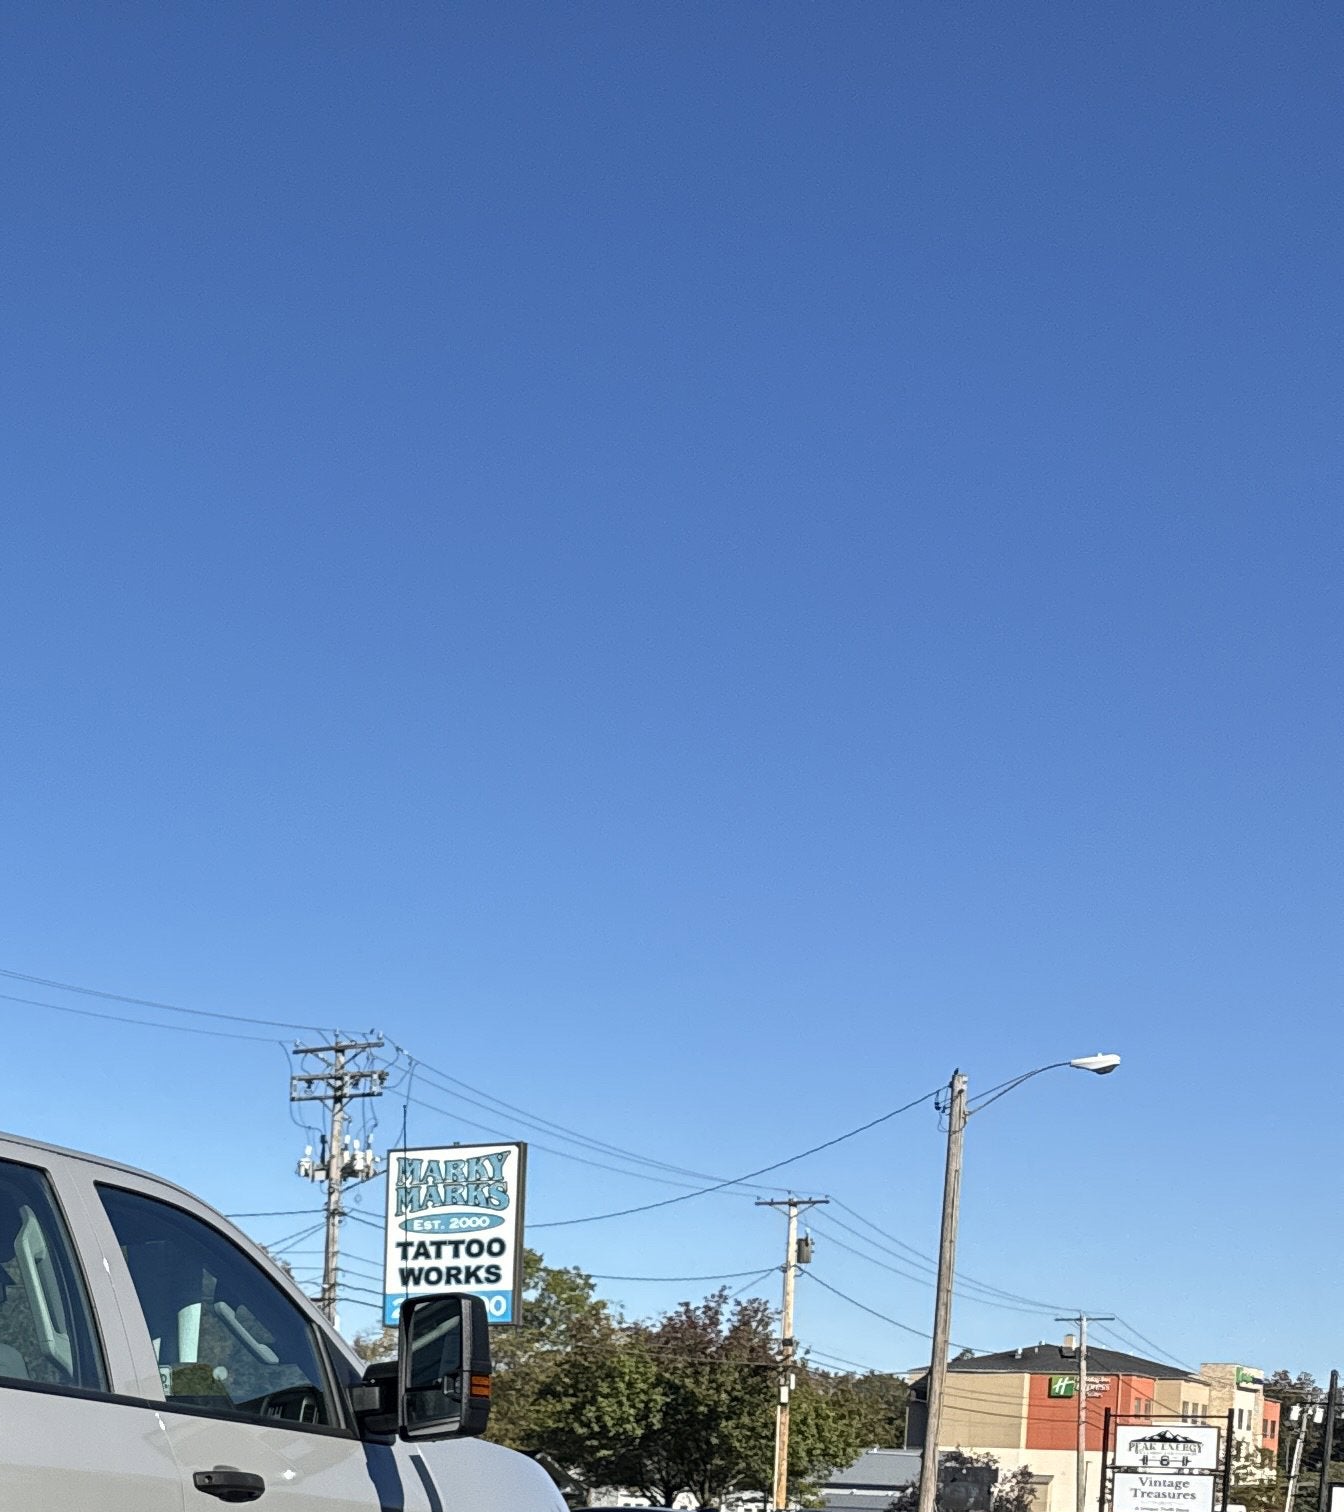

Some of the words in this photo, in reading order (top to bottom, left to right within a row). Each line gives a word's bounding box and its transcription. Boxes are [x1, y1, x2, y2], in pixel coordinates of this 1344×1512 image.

[396, 1150, 511, 1186] MARKY
[395, 1181, 510, 1217] MARKS
[450, 1216, 490, 1229] 2000
[395, 1237, 506, 1261] TATTOO
[399, 1264, 502, 1287] WORKS
[1130, 1488, 1196, 1500] Treasures
[1138, 1477, 1190, 1490] Vintage
